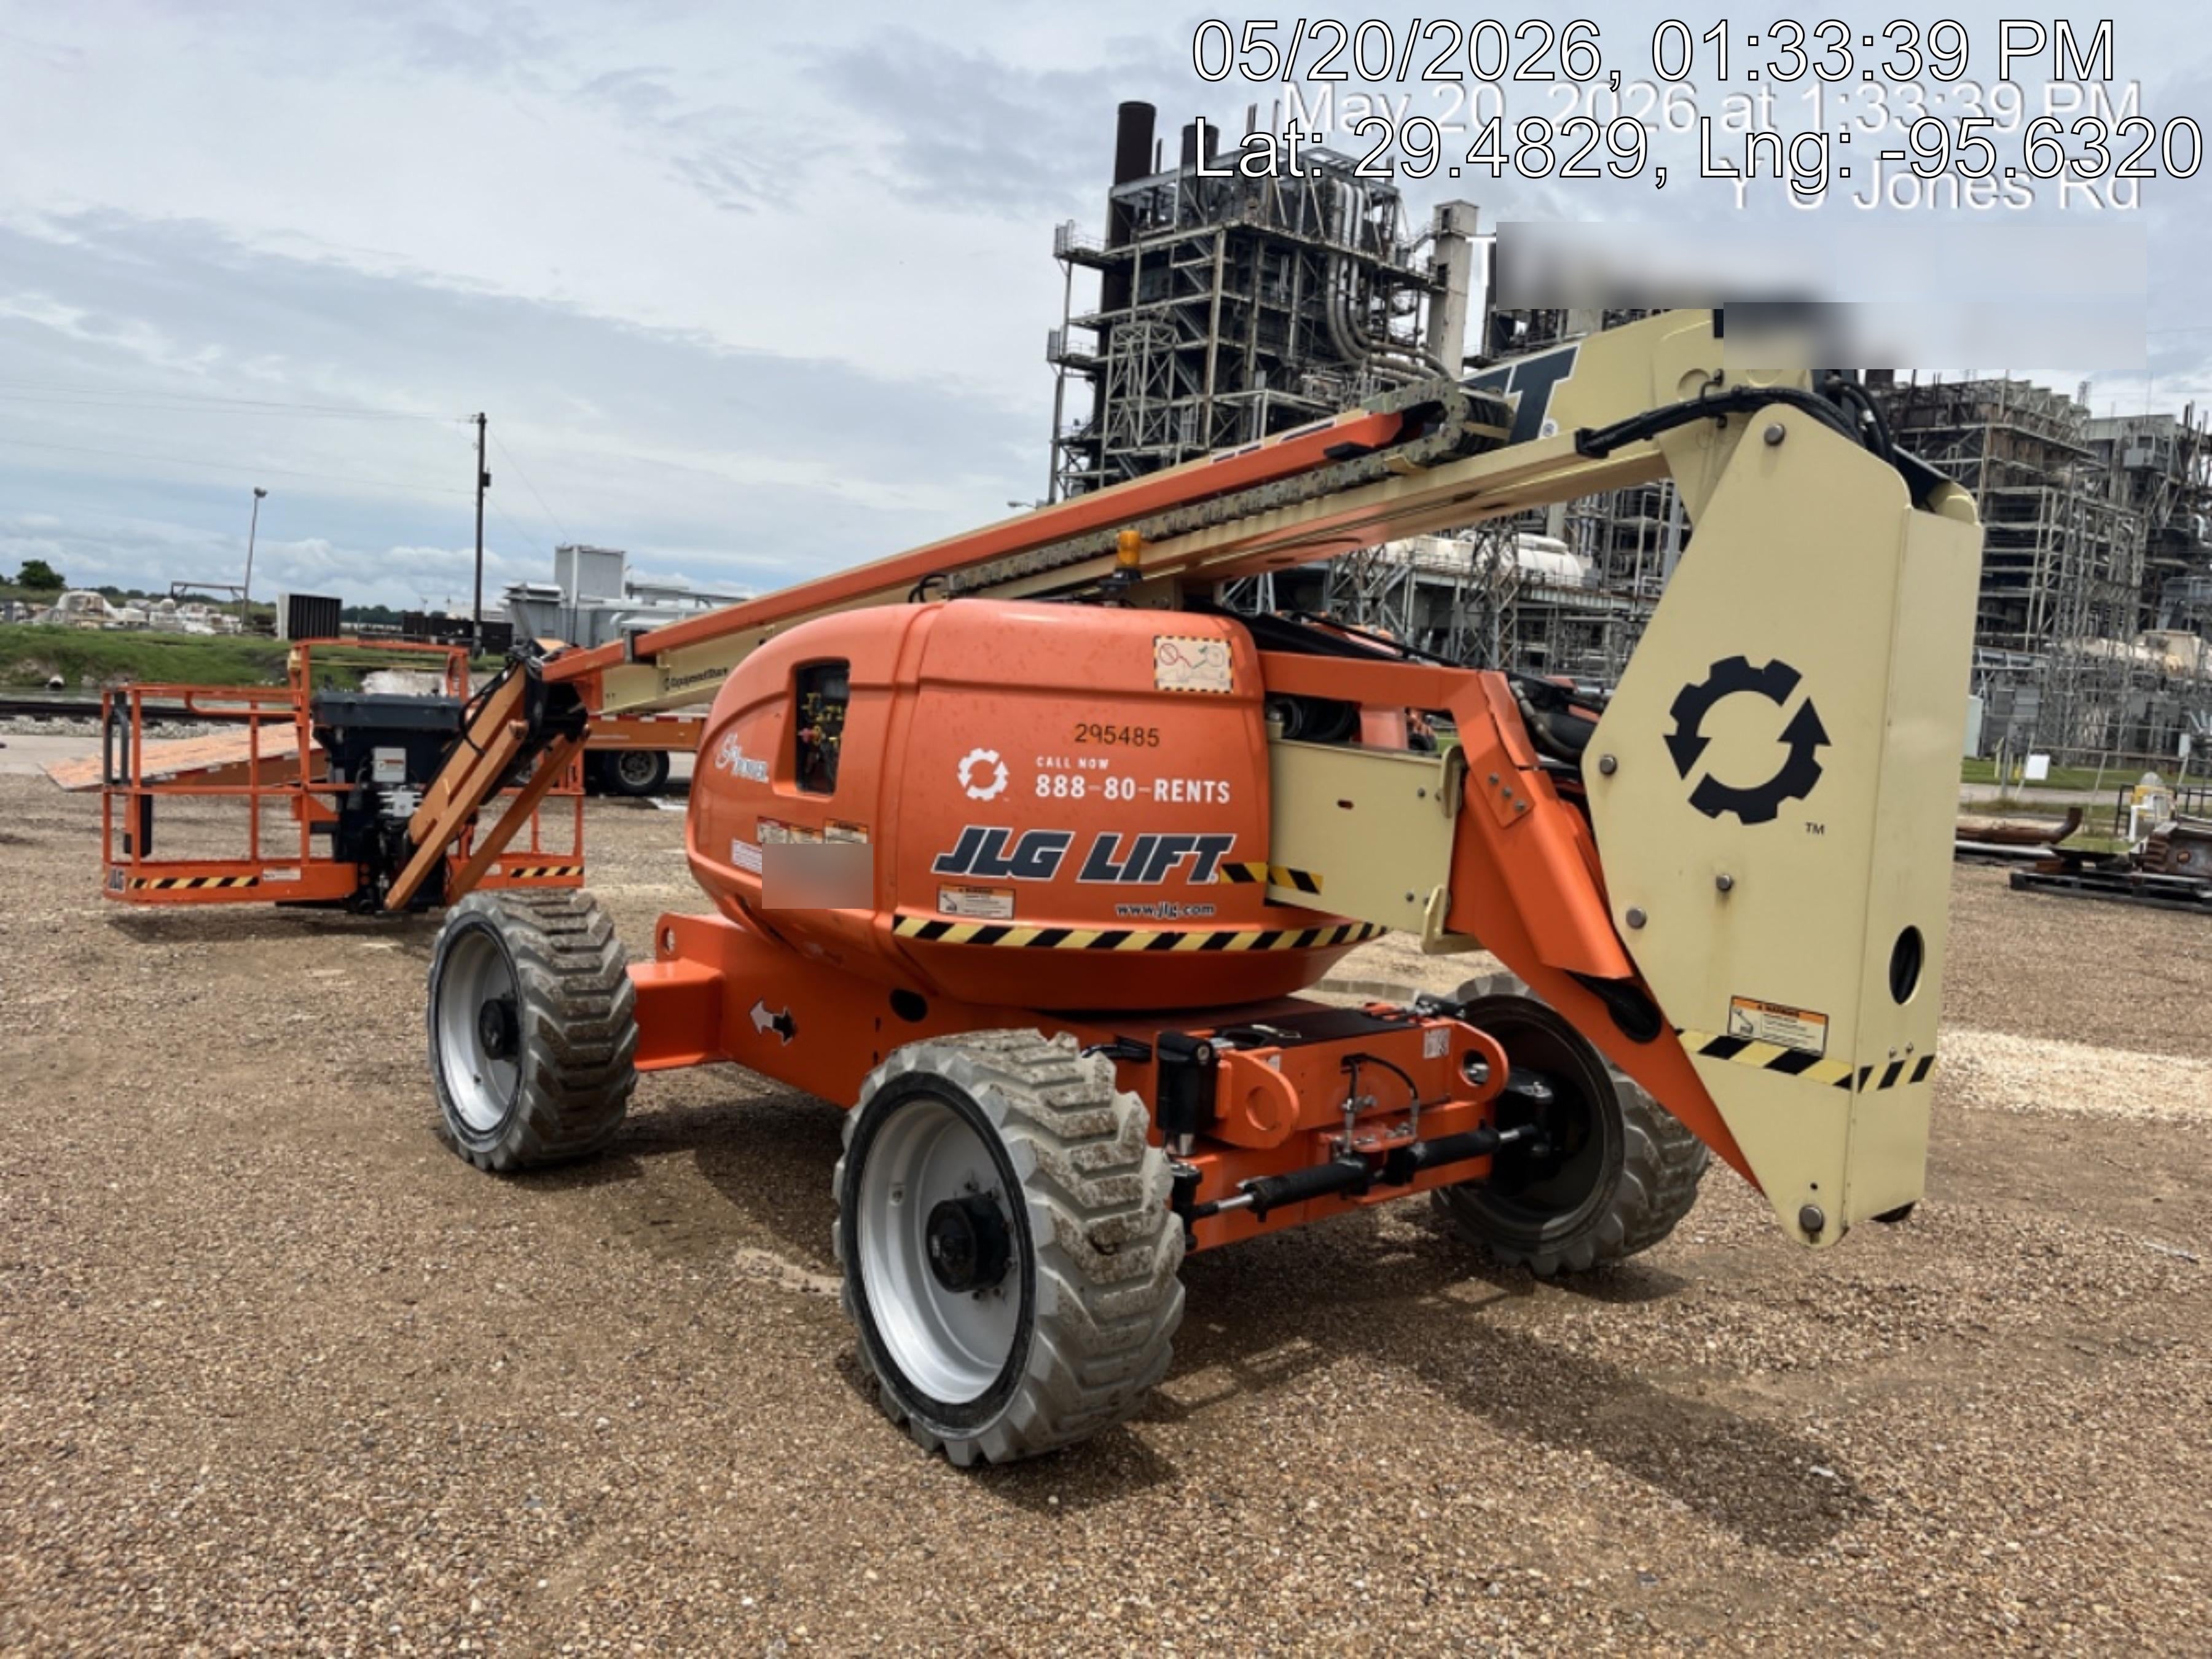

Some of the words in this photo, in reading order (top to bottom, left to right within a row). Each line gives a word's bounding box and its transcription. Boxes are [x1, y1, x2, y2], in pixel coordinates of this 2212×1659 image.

[1074, 724, 1160, 748] 295485
[1035, 756, 1072, 769] CALL
[1078, 758, 1110, 770] NOW
[1035, 774, 1231, 804] 888-80-RENTS
[931, 825, 1075, 880] JLG
[1077, 832, 1237, 885] LIFT
[1116, 902, 1215, 919] www.jlg.com
